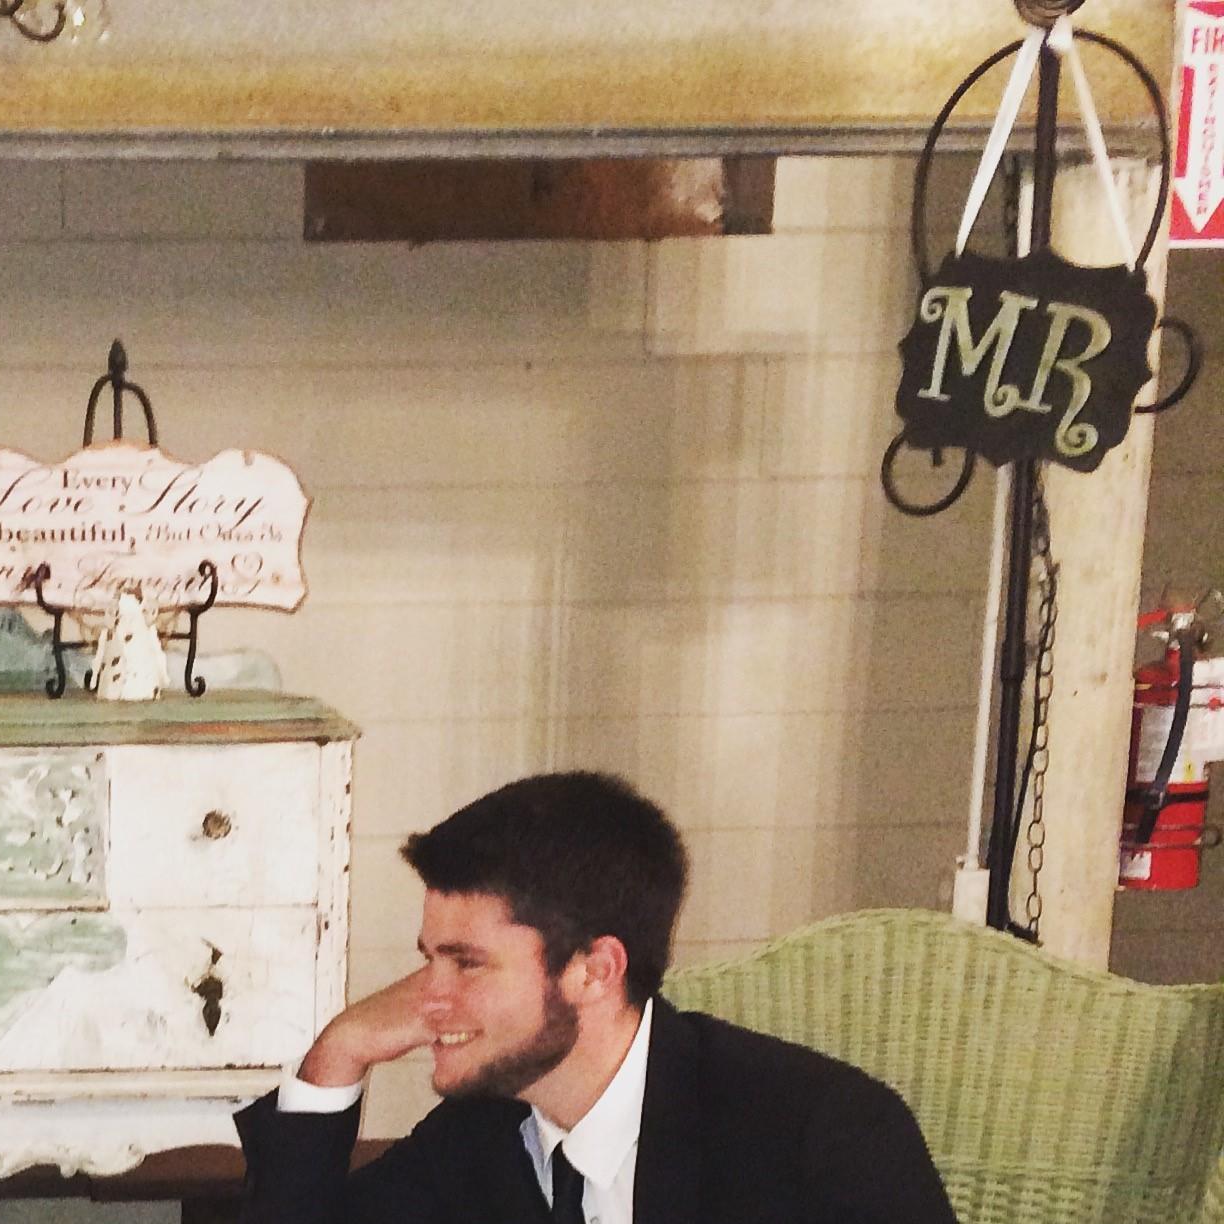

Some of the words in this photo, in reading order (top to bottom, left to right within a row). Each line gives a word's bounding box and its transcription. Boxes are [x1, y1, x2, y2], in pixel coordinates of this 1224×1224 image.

[917, 286, 1112, 456] MR
[62, 468, 133, 496] Every
[118, 469, 264, 530] Story
